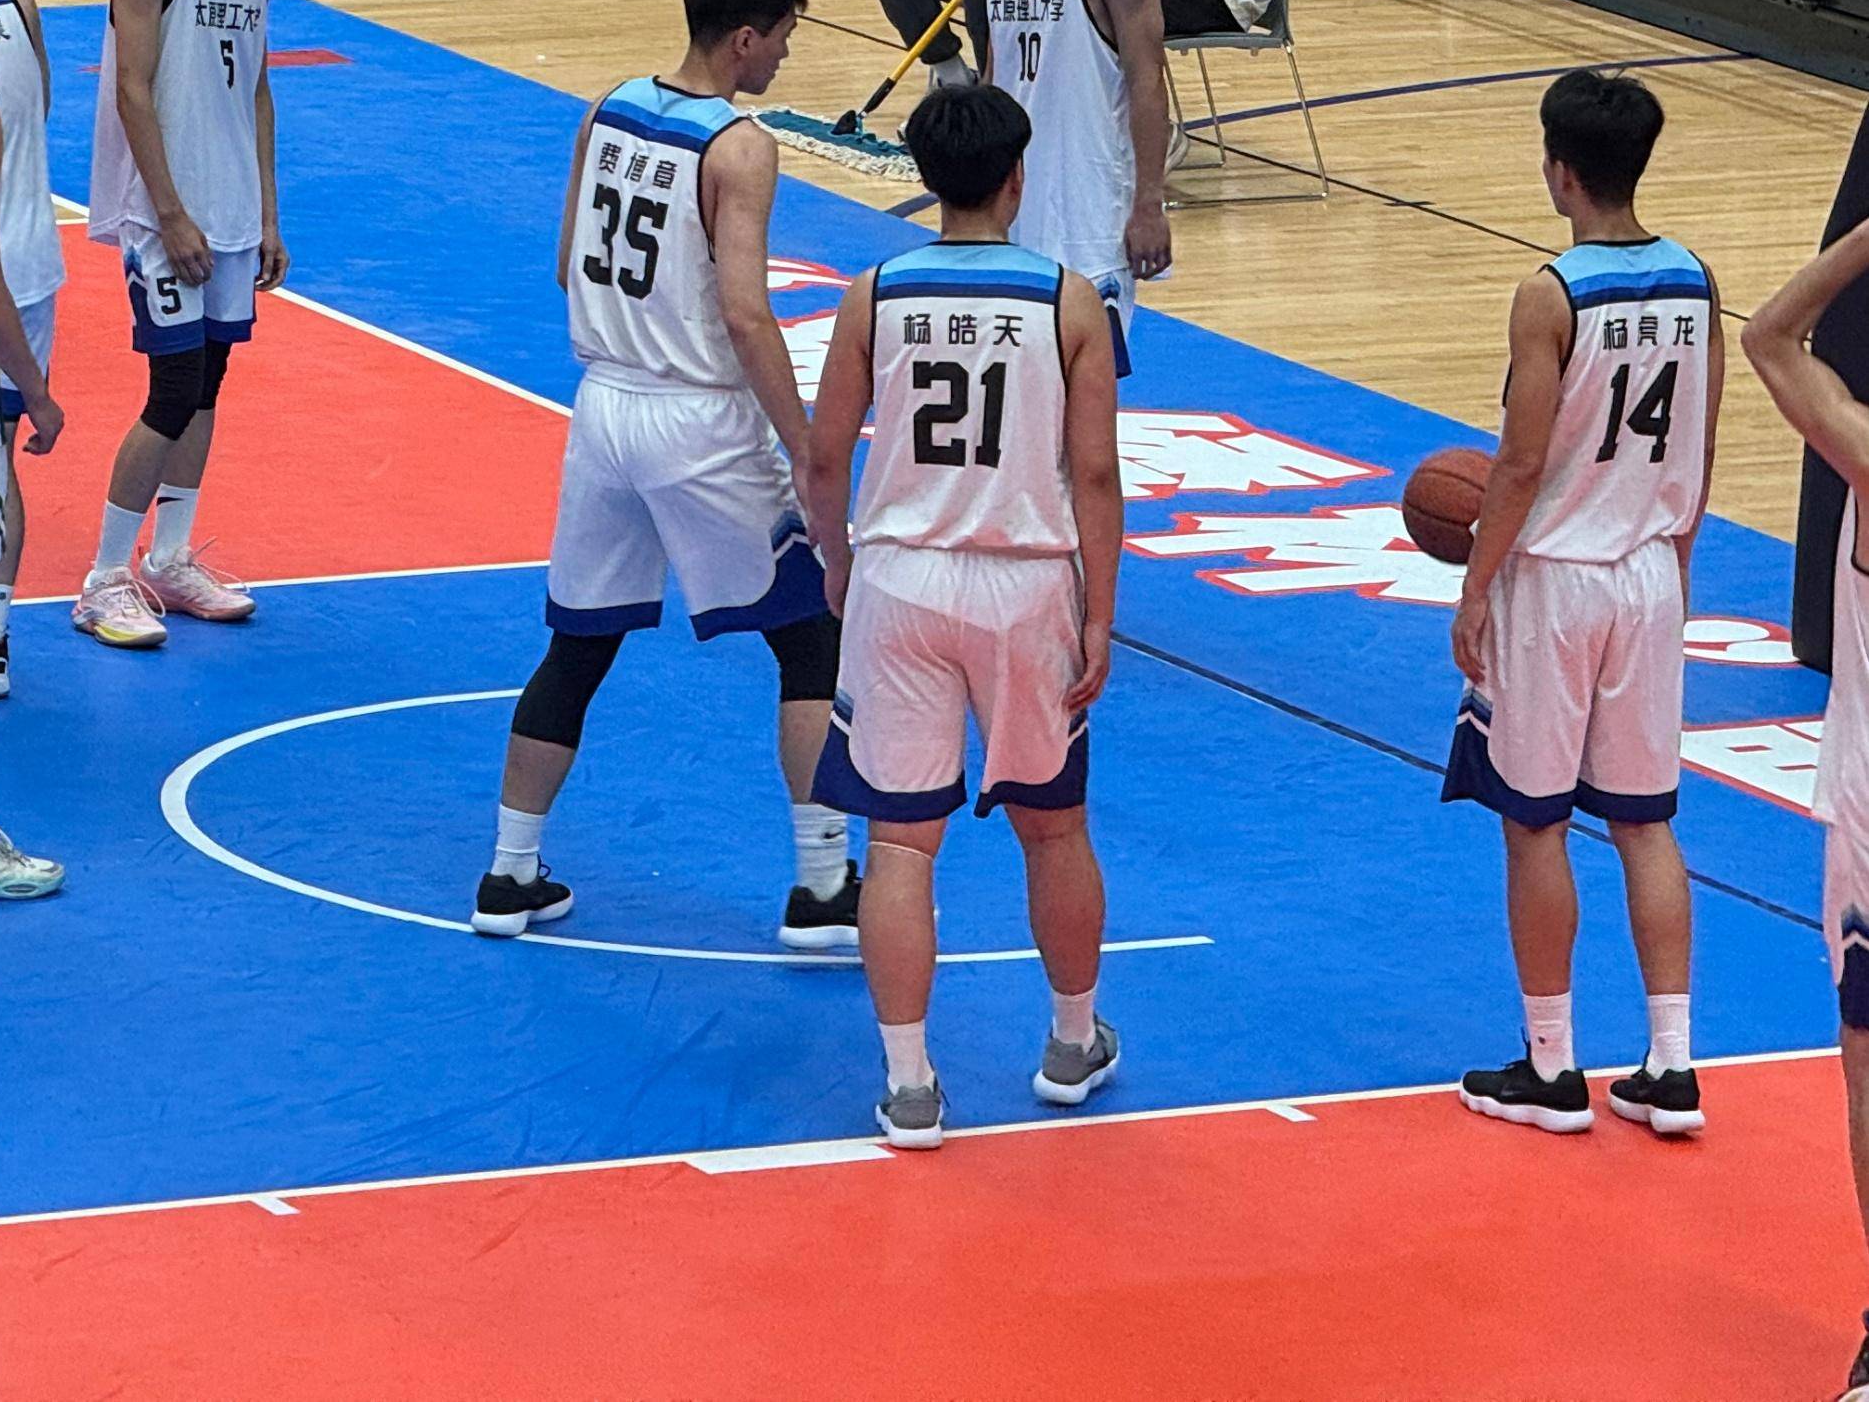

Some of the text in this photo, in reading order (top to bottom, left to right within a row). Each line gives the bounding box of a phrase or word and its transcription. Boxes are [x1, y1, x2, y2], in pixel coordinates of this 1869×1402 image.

[219, 39, 235, 90] 5
[1017, 31, 1042, 83] 10
[582, 183, 670, 301] 35
[156, 277, 182, 316] 5
[903, 312, 1024, 348] 杨皓天
[911, 360, 1007, 469] 21
[1595, 360, 1679, 464] 14
